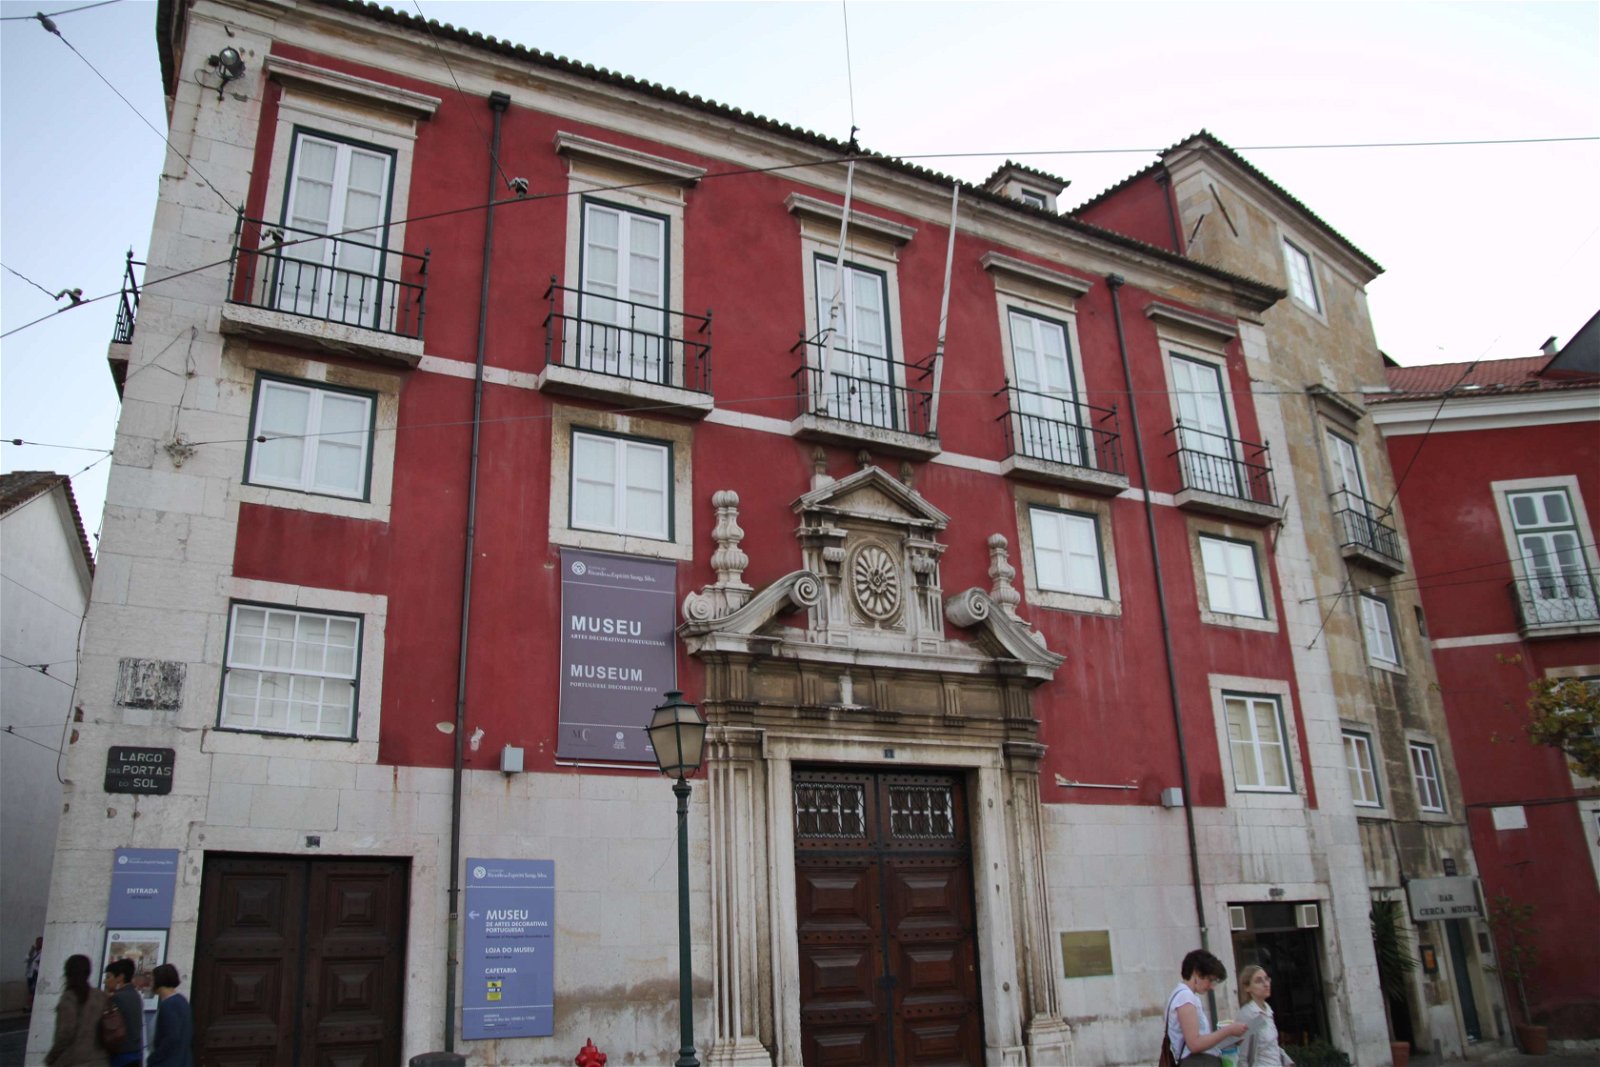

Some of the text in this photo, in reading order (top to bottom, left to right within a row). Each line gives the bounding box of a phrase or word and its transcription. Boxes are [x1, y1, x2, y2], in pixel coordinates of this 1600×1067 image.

[571, 615, 642, 636] MUSEU
[589, 635, 626, 643] DECORATIVAS
[627, 638, 666, 647] PORTUGUESAS
[570, 664, 643, 682] MUSEUM
[608, 683, 642, 692] DECORATIVE
[120, 752, 162, 763] LARGO
[122, 765, 172, 776] PORTAS
[133, 778, 159, 788] SOL
[126, 887, 159, 895] ENTRADA
[1439, 894, 1454, 902] BAR
[486, 909, 529, 920] MUSEU
[1420, 905, 1478, 916] CERCA MOURA
